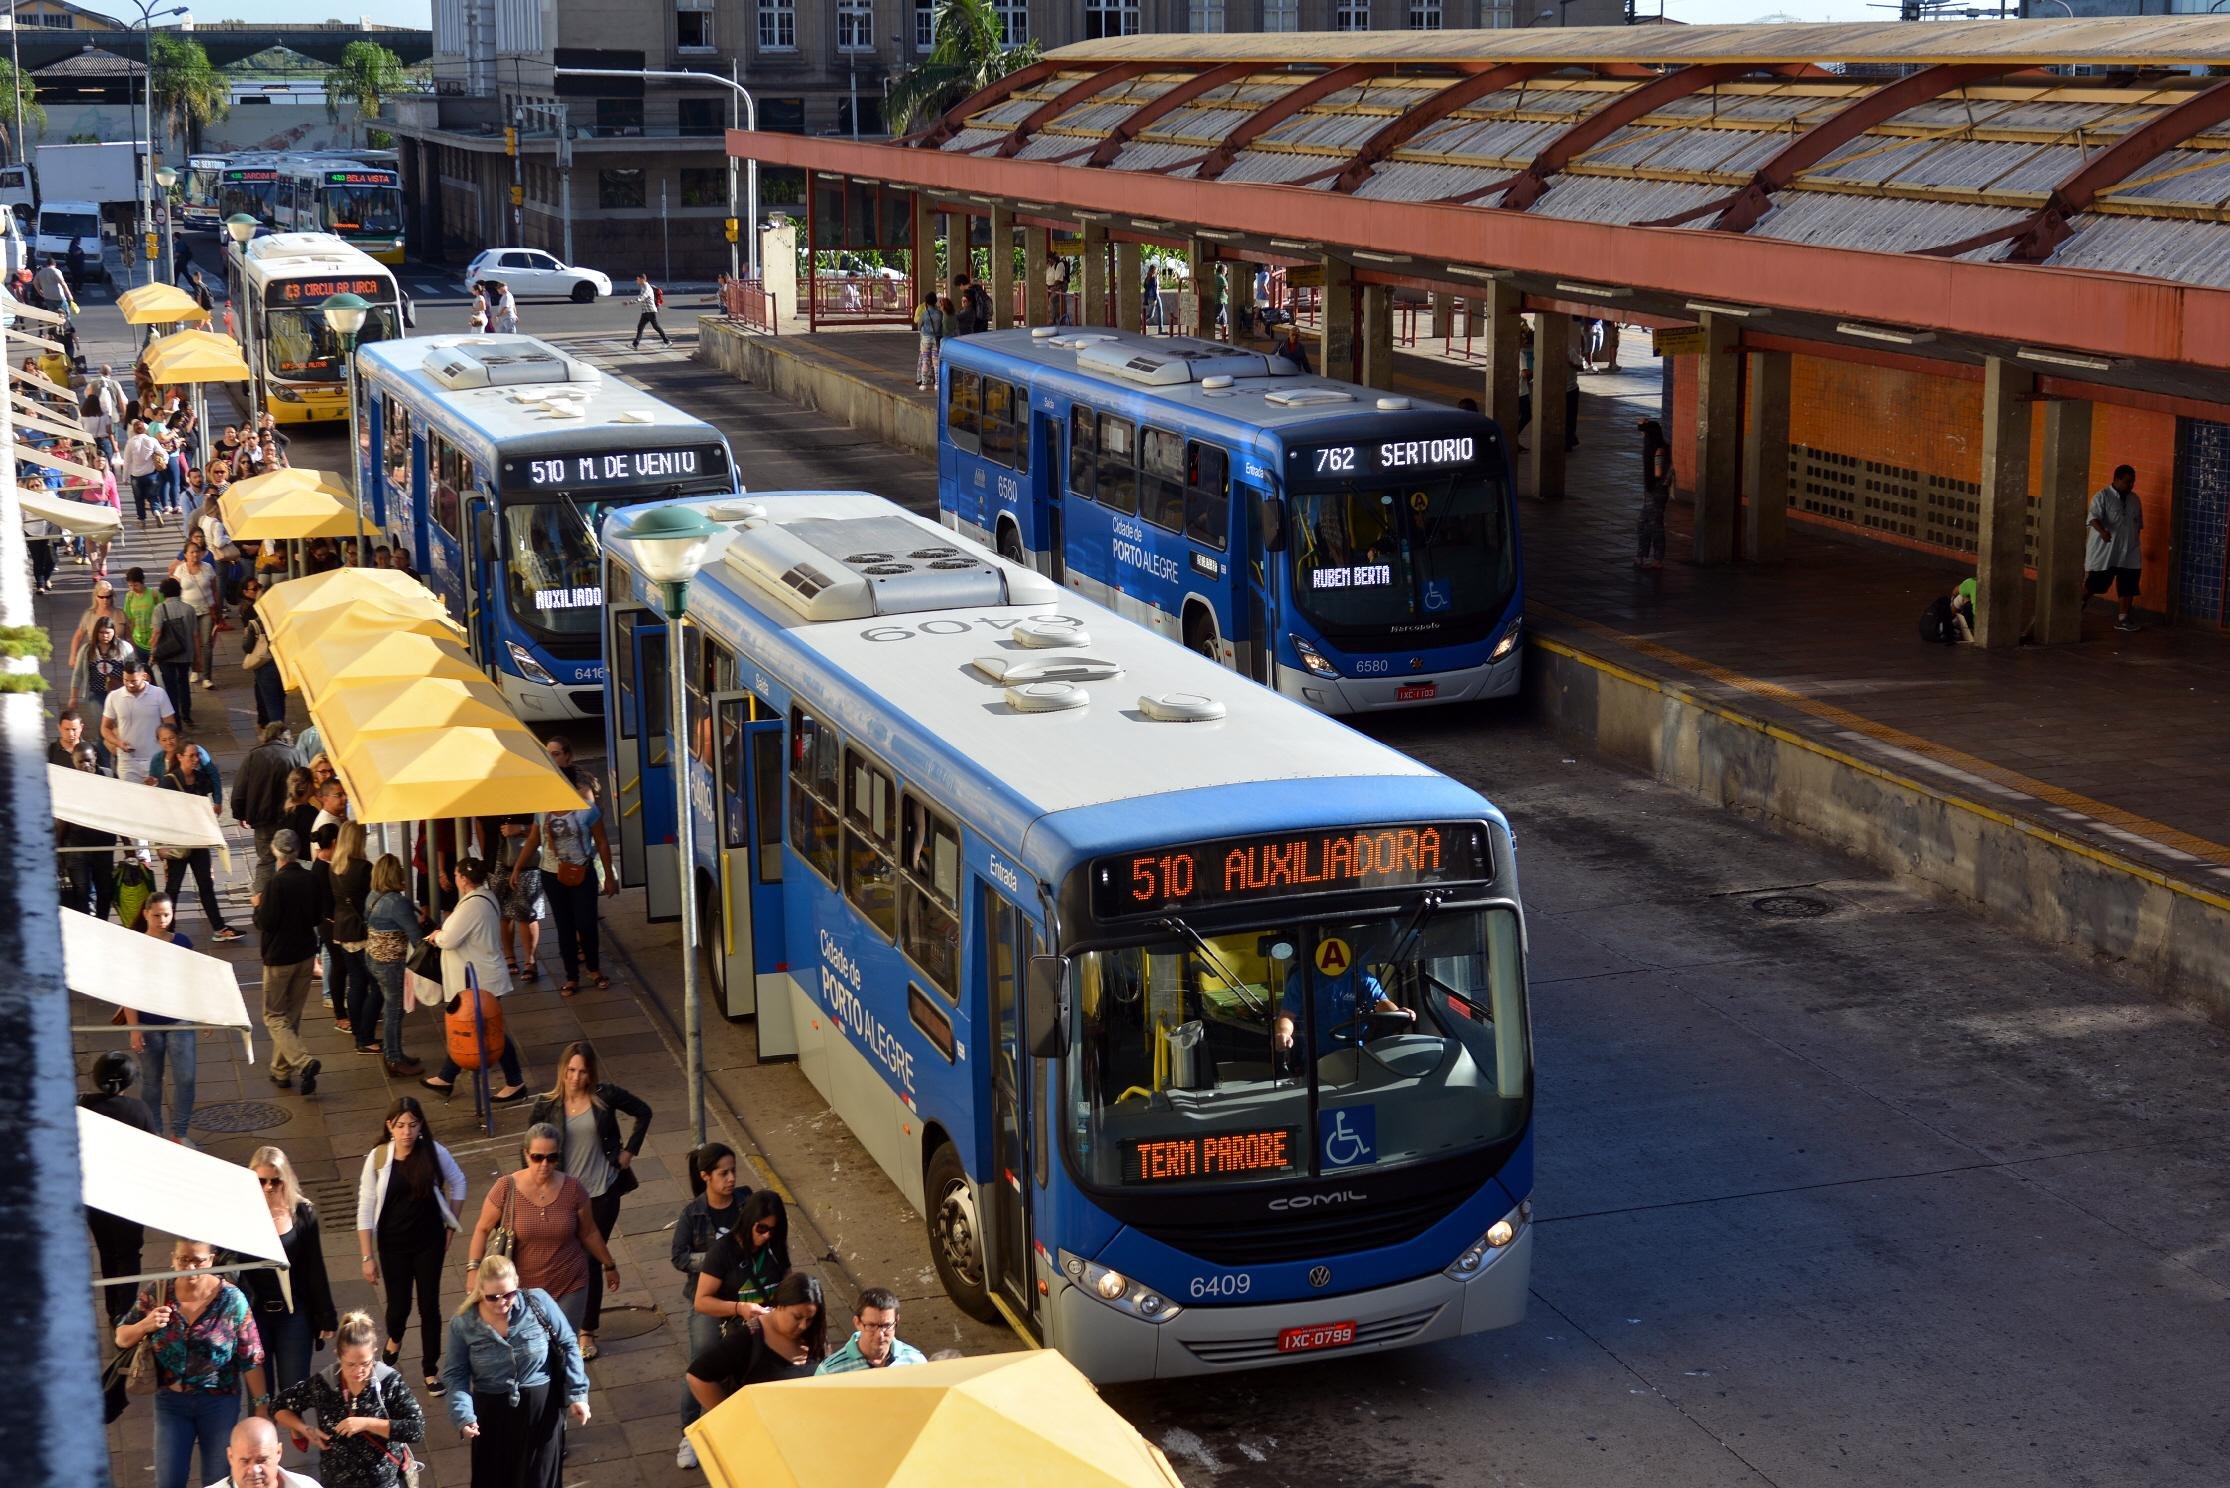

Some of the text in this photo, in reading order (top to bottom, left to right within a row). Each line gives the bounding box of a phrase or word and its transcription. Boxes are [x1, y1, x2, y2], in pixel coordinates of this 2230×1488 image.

[346, 174, 366, 182] BELA
[367, 174, 390, 183] VISTA
[285, 280, 377, 298] C3 CIRCULAR URCA
[1317, 437, 1473, 472] 762 SERTORIO
[531, 460, 565, 484] 510
[604, 455, 629, 478] DE
[998, 475, 1018, 502] 6580
[1414, 494, 1426, 508] A
[1112, 516, 1143, 543] Cidade de
[1113, 539, 1142, 570] PORTO
[1142, 552, 1179, 585] ALEGRE
[1313, 565, 1390, 588] RUBEM BERTA
[1356, 659, 1388, 673] 6580
[690, 771, 712, 822] 6409
[990, 854, 1017, 893] Entrada
[1132, 827, 1441, 901] 510 AUXILIADORA
[820, 928, 861, 991] Cidade de
[1320, 941, 1347, 969] A
[822, 964, 916, 1095] PORTO ALEGRE
[1138, 1131, 1288, 1179] TERM PAROBE
[1268, 1190, 1367, 1210] COMIL
[1190, 1273, 1251, 1298] 6409
